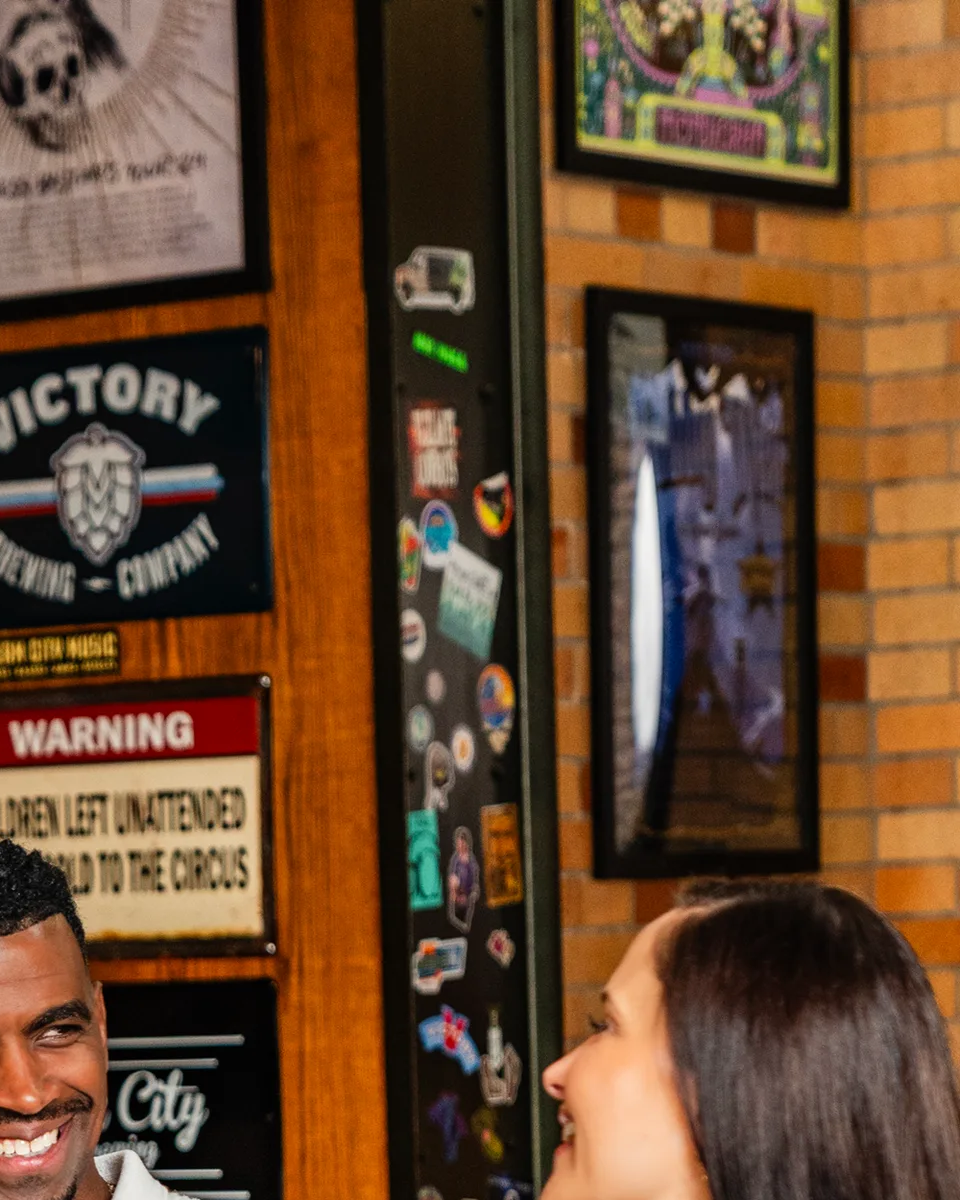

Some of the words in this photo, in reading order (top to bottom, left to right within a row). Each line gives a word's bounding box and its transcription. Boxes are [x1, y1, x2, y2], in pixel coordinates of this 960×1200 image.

[116, 512, 220, 601] COMPANY
[8, 710, 195, 758] WARNING
[66, 793, 108, 837] LEFT
[112, 787, 247, 835] UNATTENDED
[98, 850, 125, 894] TO
[128, 848, 166, 893] THE
[170, 846, 249, 891] CIRCUS
[117, 1068, 210, 1151] City
